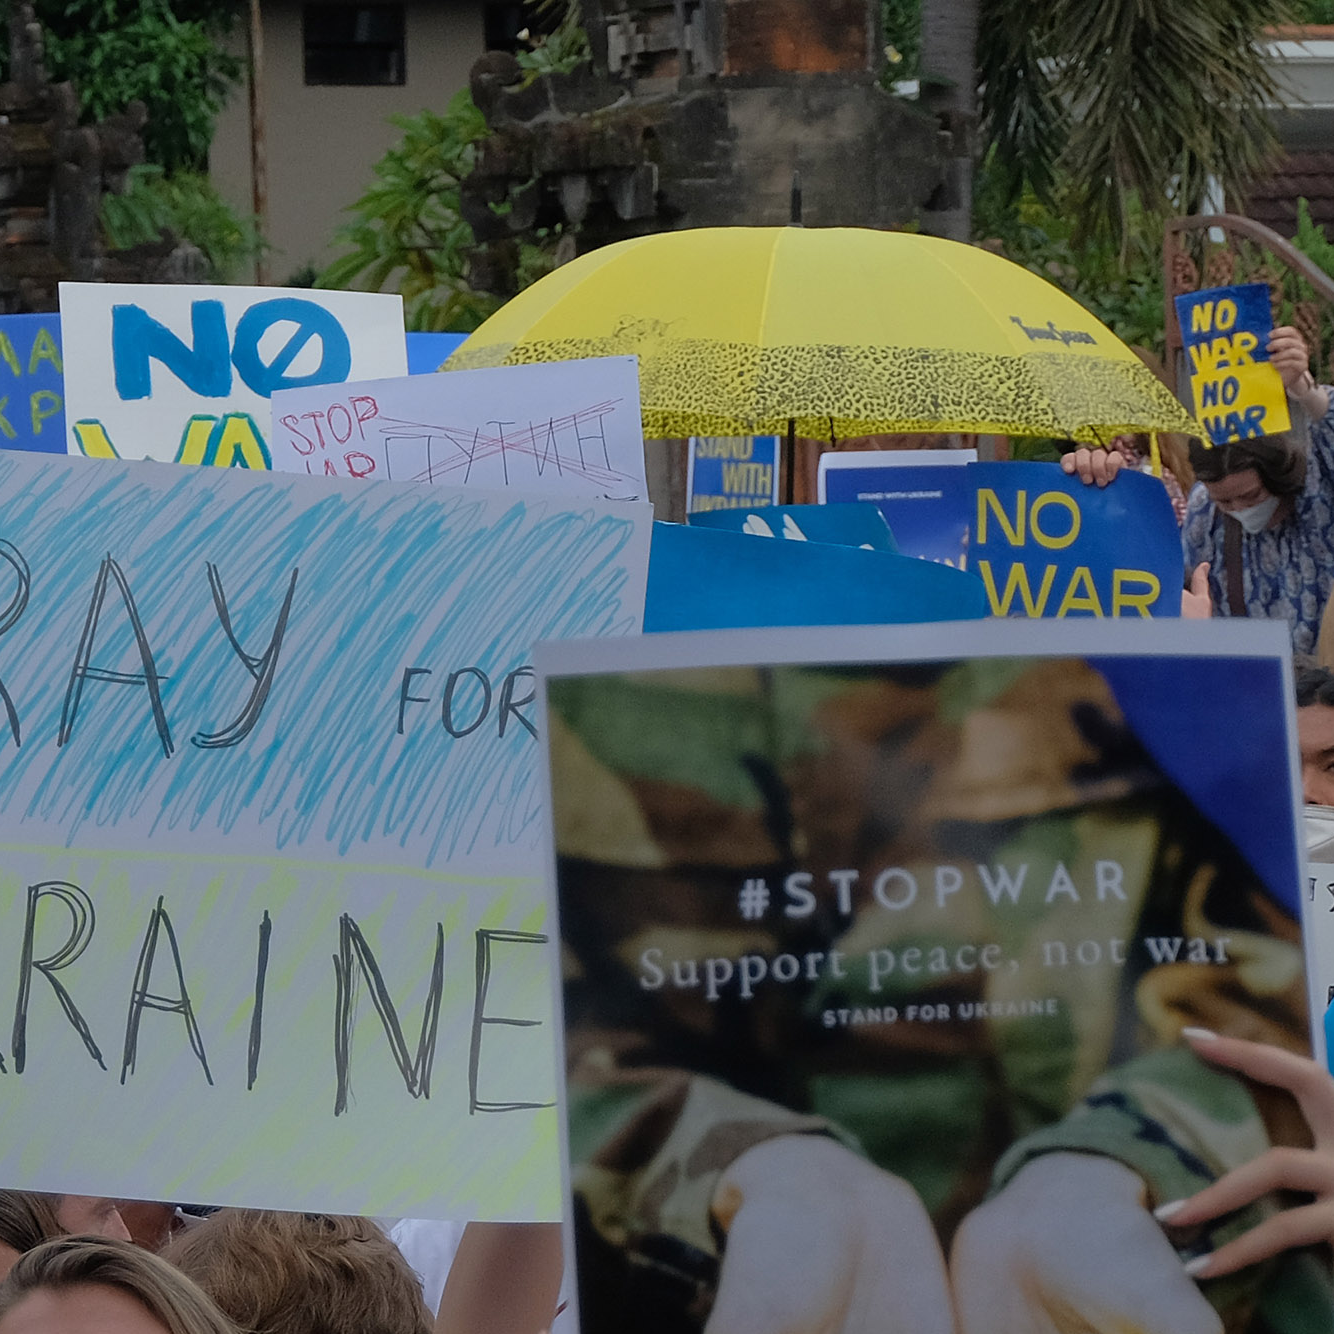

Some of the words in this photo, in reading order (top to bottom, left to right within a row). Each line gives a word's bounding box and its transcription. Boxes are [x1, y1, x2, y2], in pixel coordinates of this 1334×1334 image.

[1191, 299, 1238, 333] NO
[111, 297, 352, 400] NO
[1189, 332, 1258, 373] WAR
[1202, 376, 1239, 408] NO
[280, 396, 379, 457] STOP
[1203, 405, 1266, 446] WAR
[976, 488, 1081, 549] NO
[977, 561, 1161, 619] WAR
[398, 664, 539, 741] FOR
[638, 948, 848, 1001] Support
[869, 941, 1021, 993] peace,
[1043, 936, 1126, 969] not
[1145, 936, 1231, 967] war
[822, 1005, 899, 1029] STAND
[906, 1002, 951, 1024] FOR
[958, 997, 1058, 1021] UKRAINE
